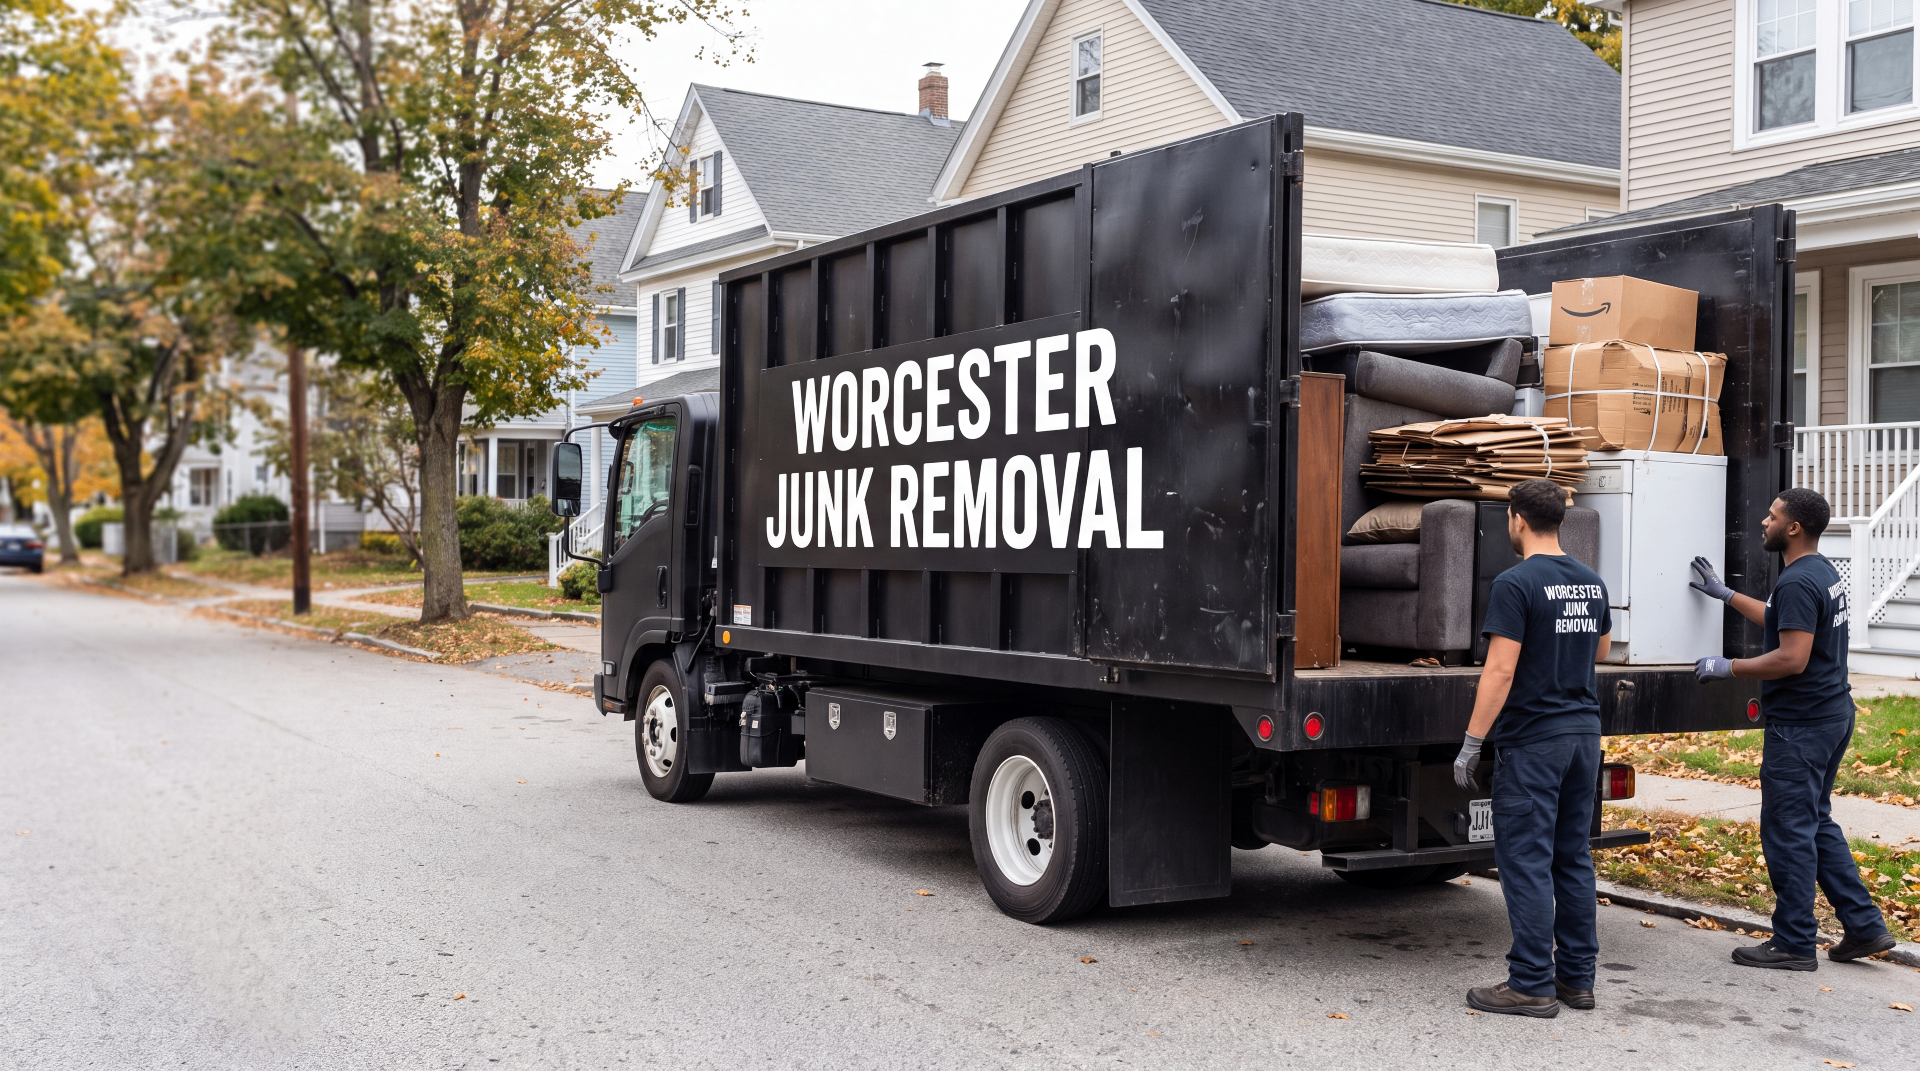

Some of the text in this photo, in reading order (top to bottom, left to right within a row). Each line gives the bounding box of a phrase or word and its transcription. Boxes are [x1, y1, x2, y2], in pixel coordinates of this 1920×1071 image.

[792, 328, 1117, 454] WORCESTER
[767, 446, 1164, 549] JUNK REMOVAL
[1544, 584, 1603, 601] WORCESTER
[1563, 601, 1590, 617] JUNK
[1555, 618, 1598, 634] REMOVAL
